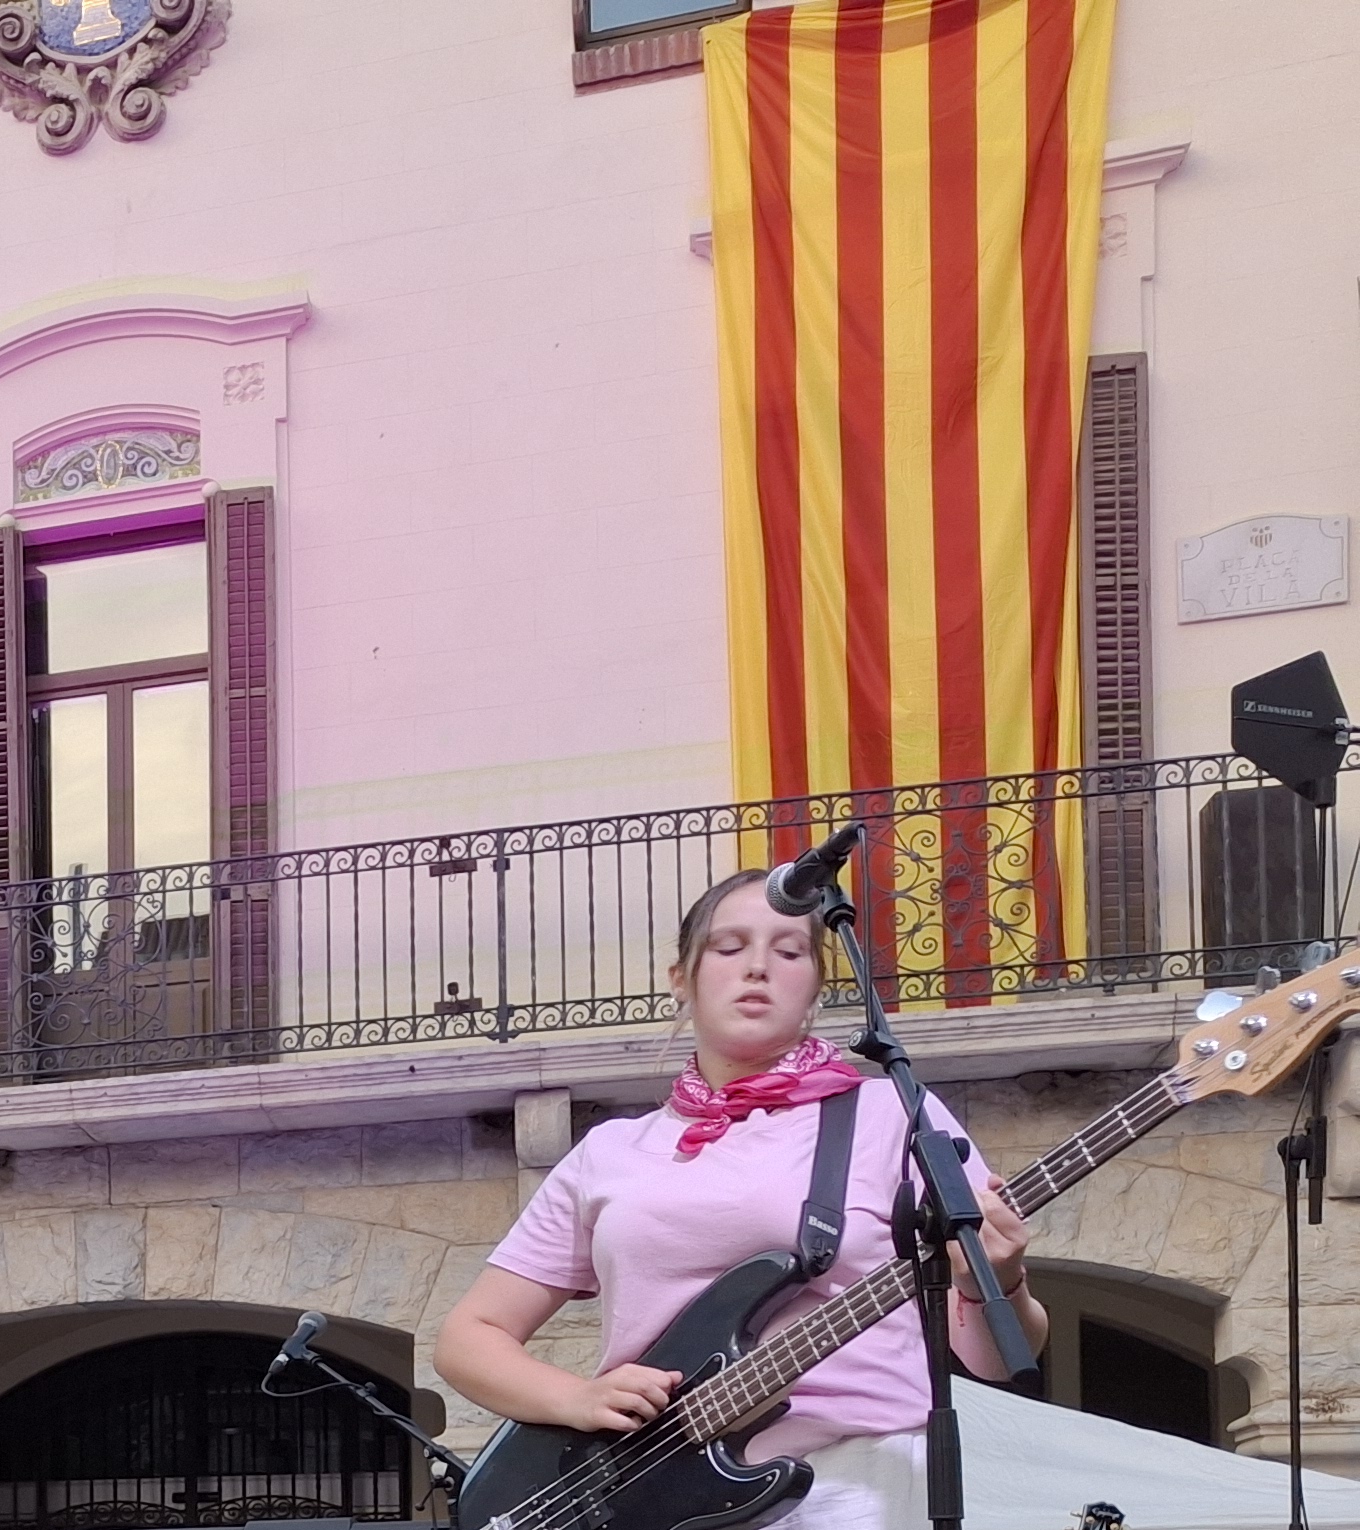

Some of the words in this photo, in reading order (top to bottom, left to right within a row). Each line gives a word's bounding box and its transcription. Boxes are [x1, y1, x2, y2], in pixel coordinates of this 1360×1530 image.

[1220, 579, 1302, 608] VILA
[1257, 704, 1314, 719] SENNHEISER
[807, 1215, 838, 1236] Basso
